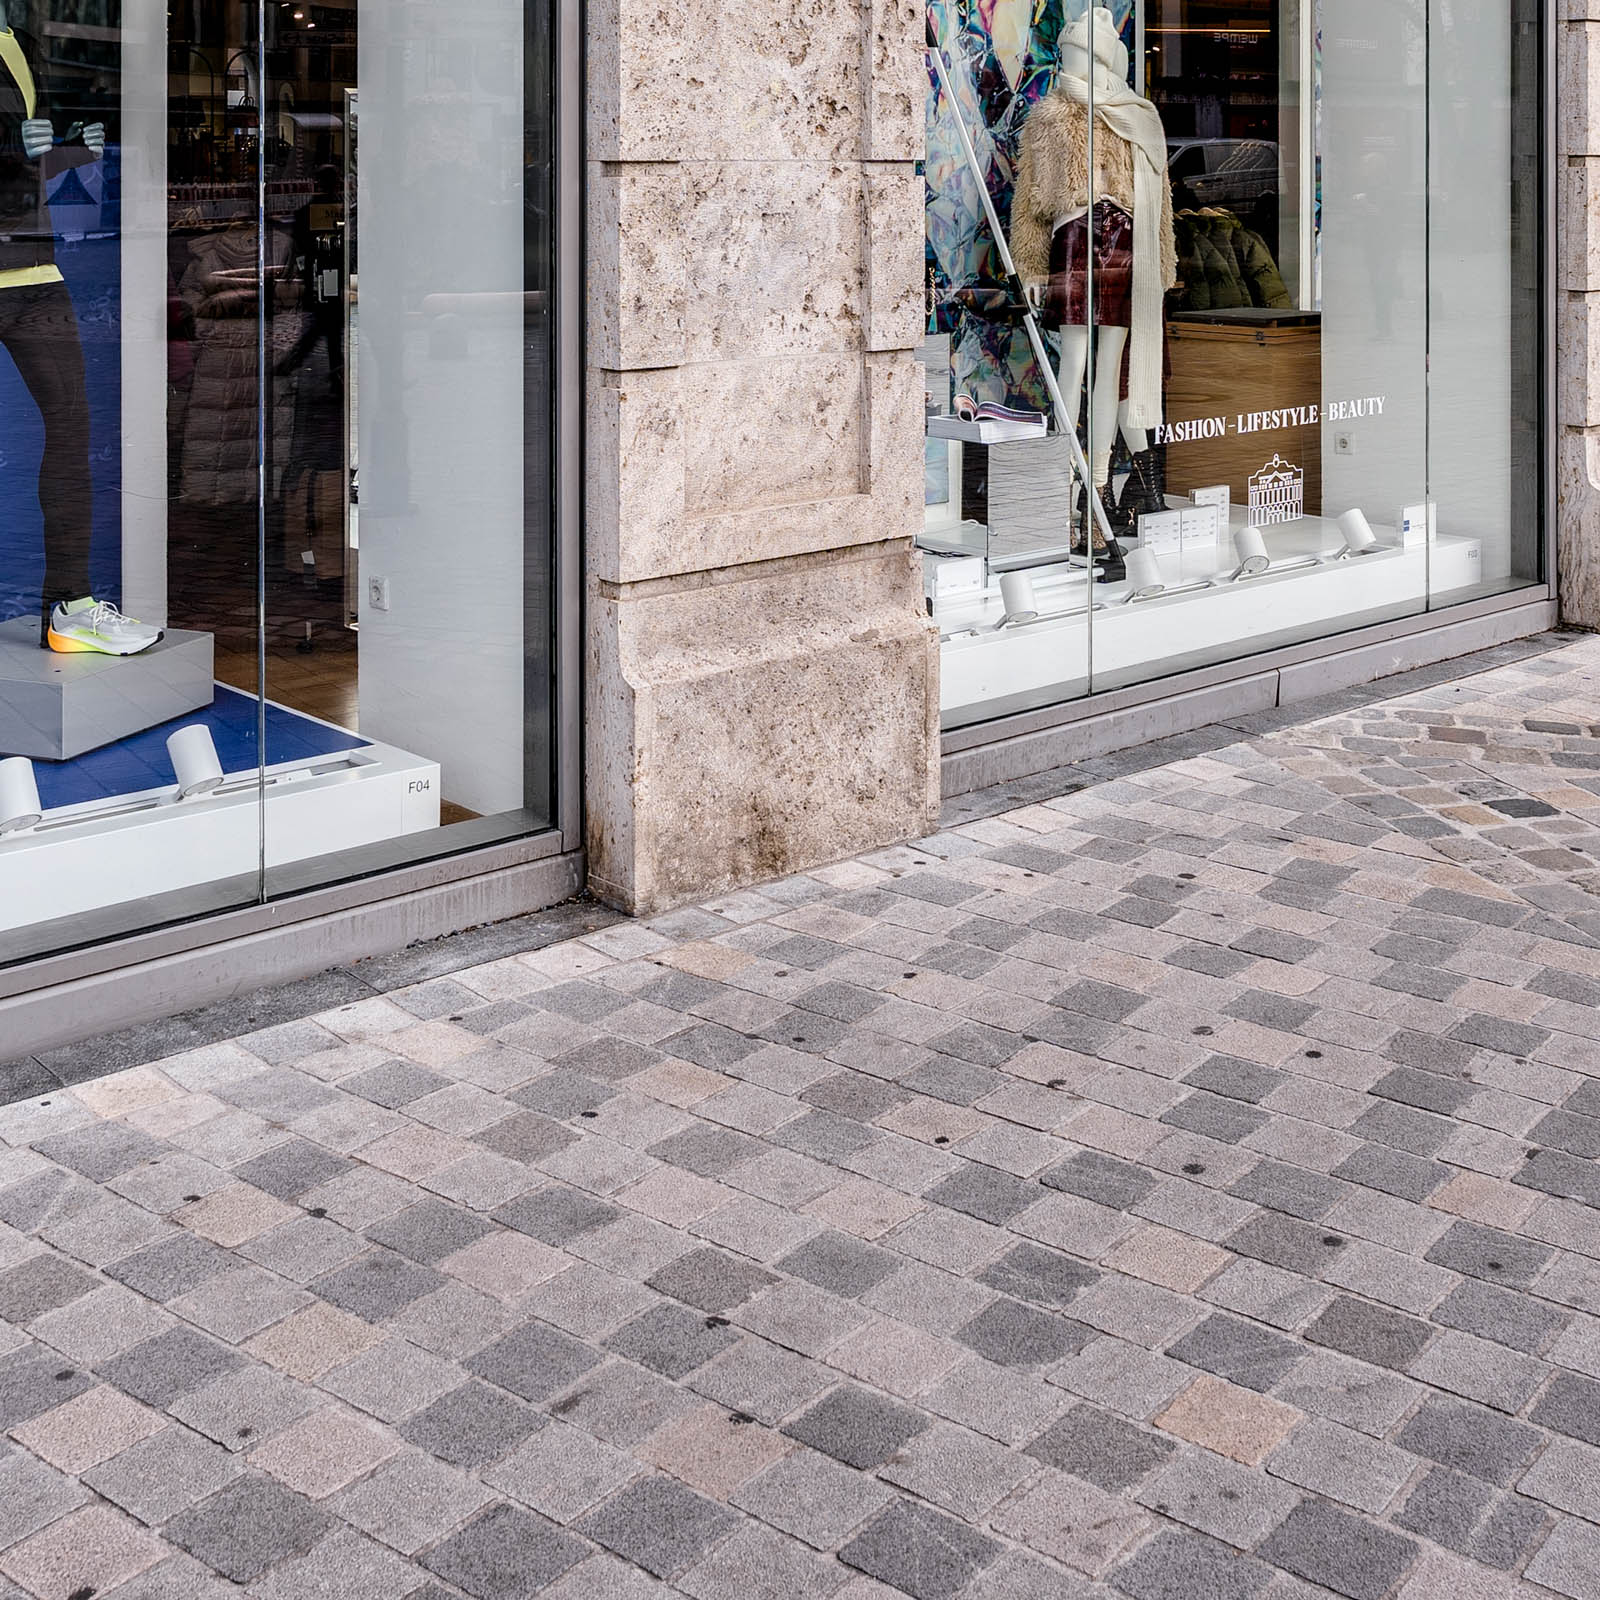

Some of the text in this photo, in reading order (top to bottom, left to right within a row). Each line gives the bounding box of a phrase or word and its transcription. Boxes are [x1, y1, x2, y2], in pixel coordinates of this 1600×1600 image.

[1154, 416, 1227, 445] FASHION
[1237, 404, 1318, 434] LIFESTYLE
[1328, 396, 1386, 421] BEAUTY
[408, 779, 430, 795] F04
